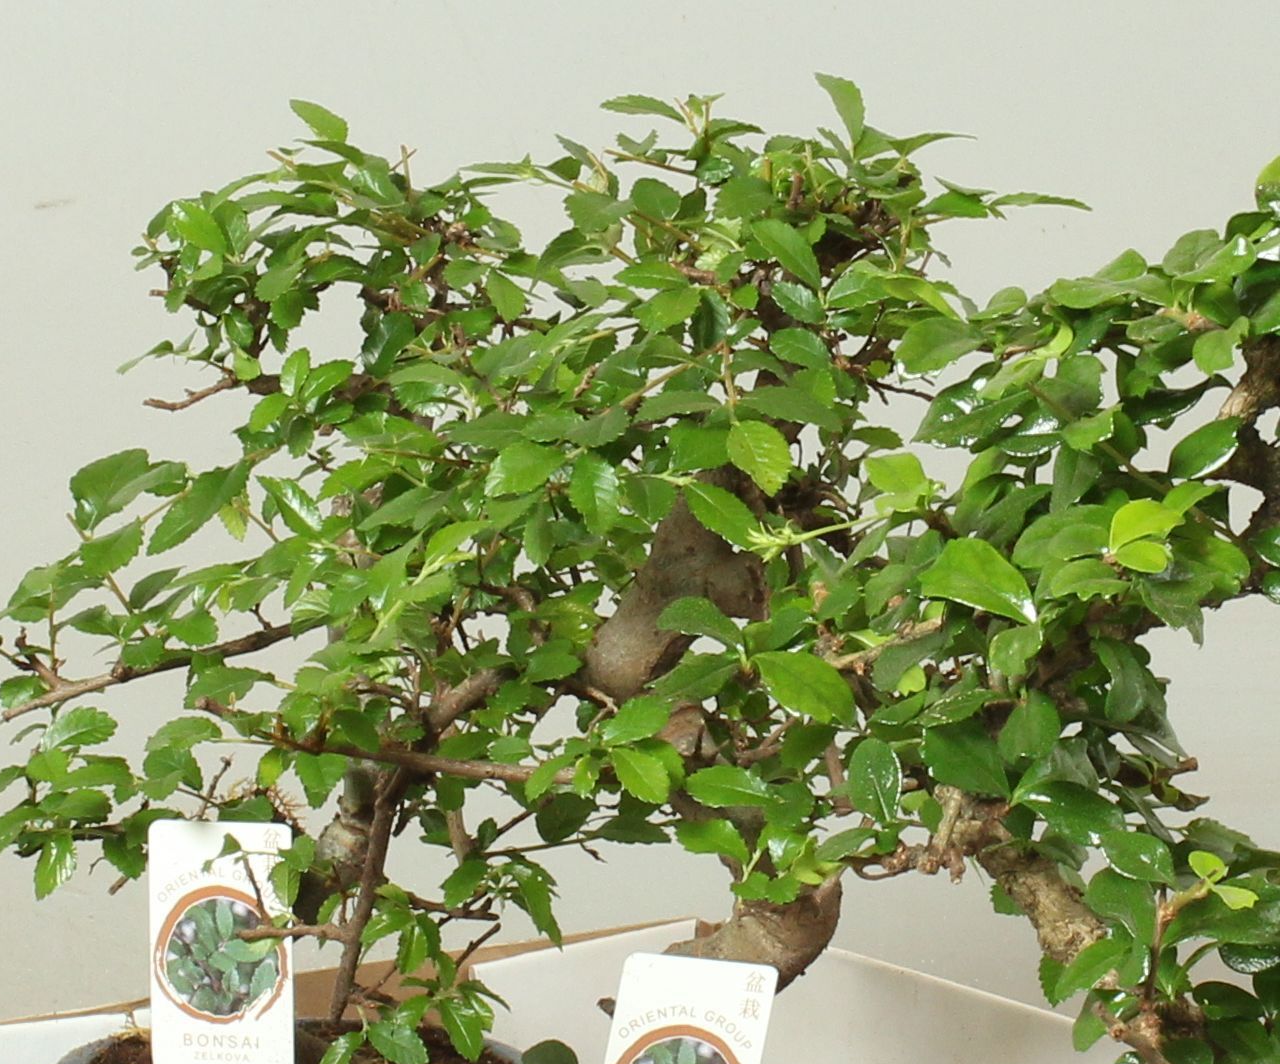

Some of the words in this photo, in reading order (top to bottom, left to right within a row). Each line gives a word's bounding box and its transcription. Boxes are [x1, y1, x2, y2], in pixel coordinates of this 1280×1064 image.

[739, 971, 767, 1020] 盆栽
[183, 1033, 260, 1049] BONSAI
[618, 1005, 697, 1039] ORIENTAL
[704, 1010, 753, 1050] GROUP
[194, 1051, 250, 1063] ZELKOVA
